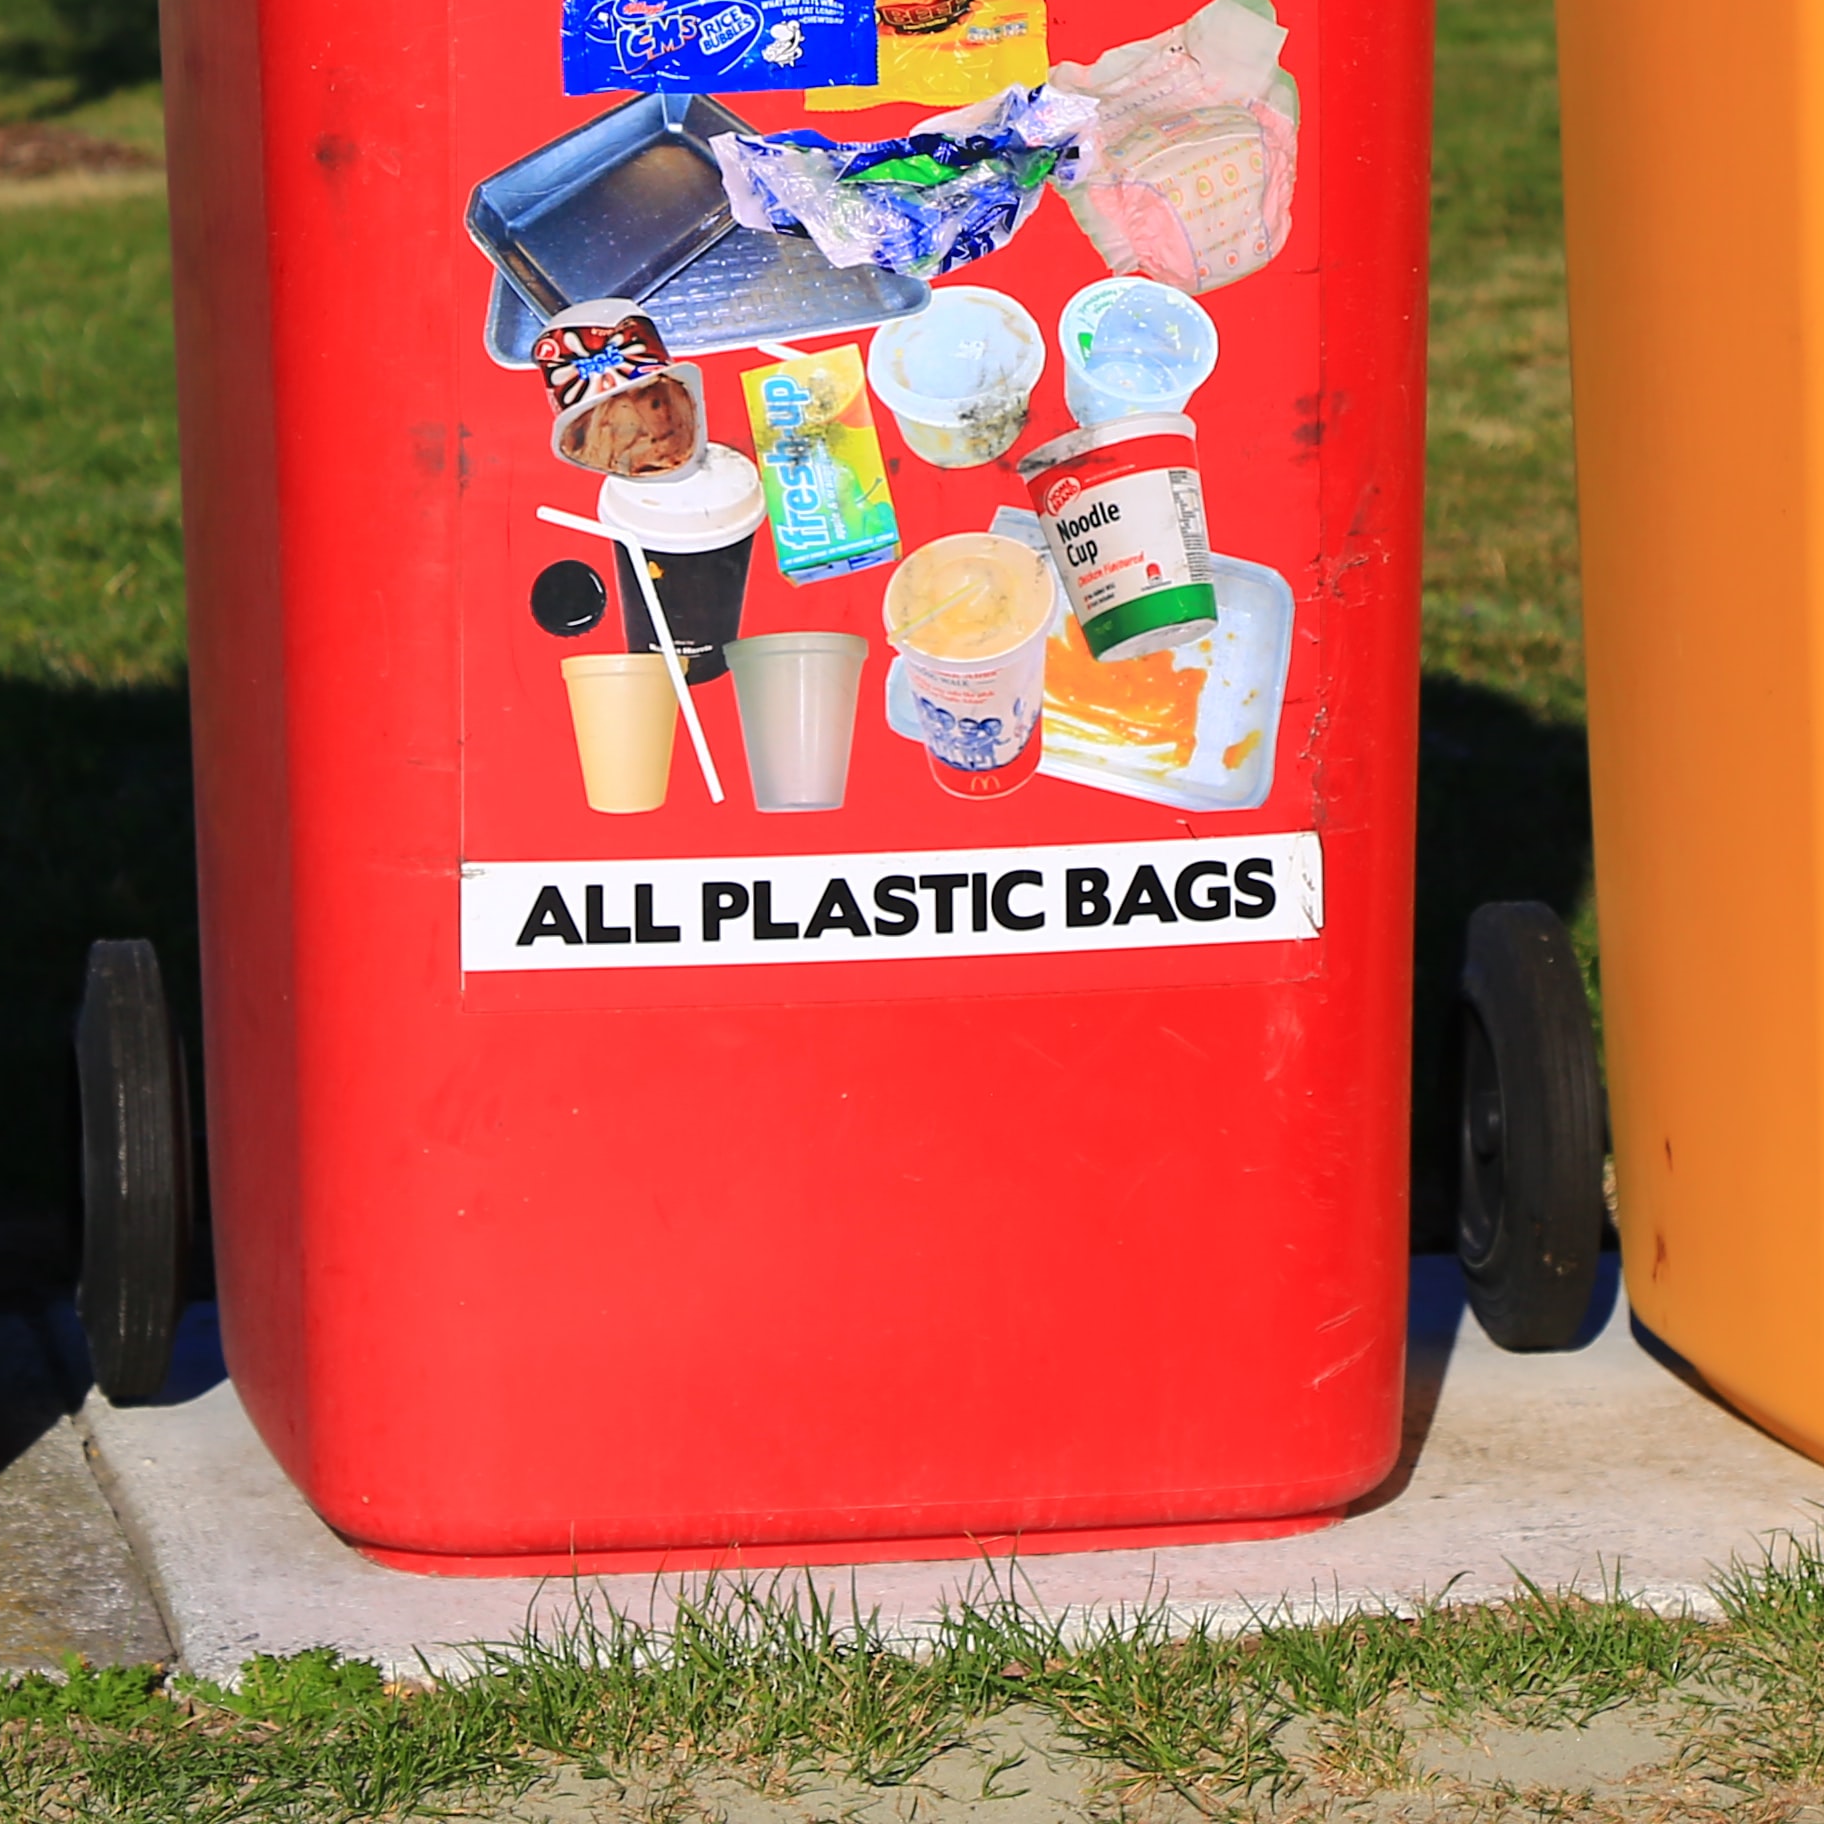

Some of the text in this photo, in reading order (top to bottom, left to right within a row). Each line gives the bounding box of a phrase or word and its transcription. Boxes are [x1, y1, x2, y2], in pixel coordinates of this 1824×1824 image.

[703, 16, 754, 53] BUBBLES
[705, 6, 744, 37] RICE
[1056, 501, 1121, 545] Noodle
[1066, 539, 1099, 568] Cup
[516, 856, 1277, 947] ALL PLASTIC BAGS
